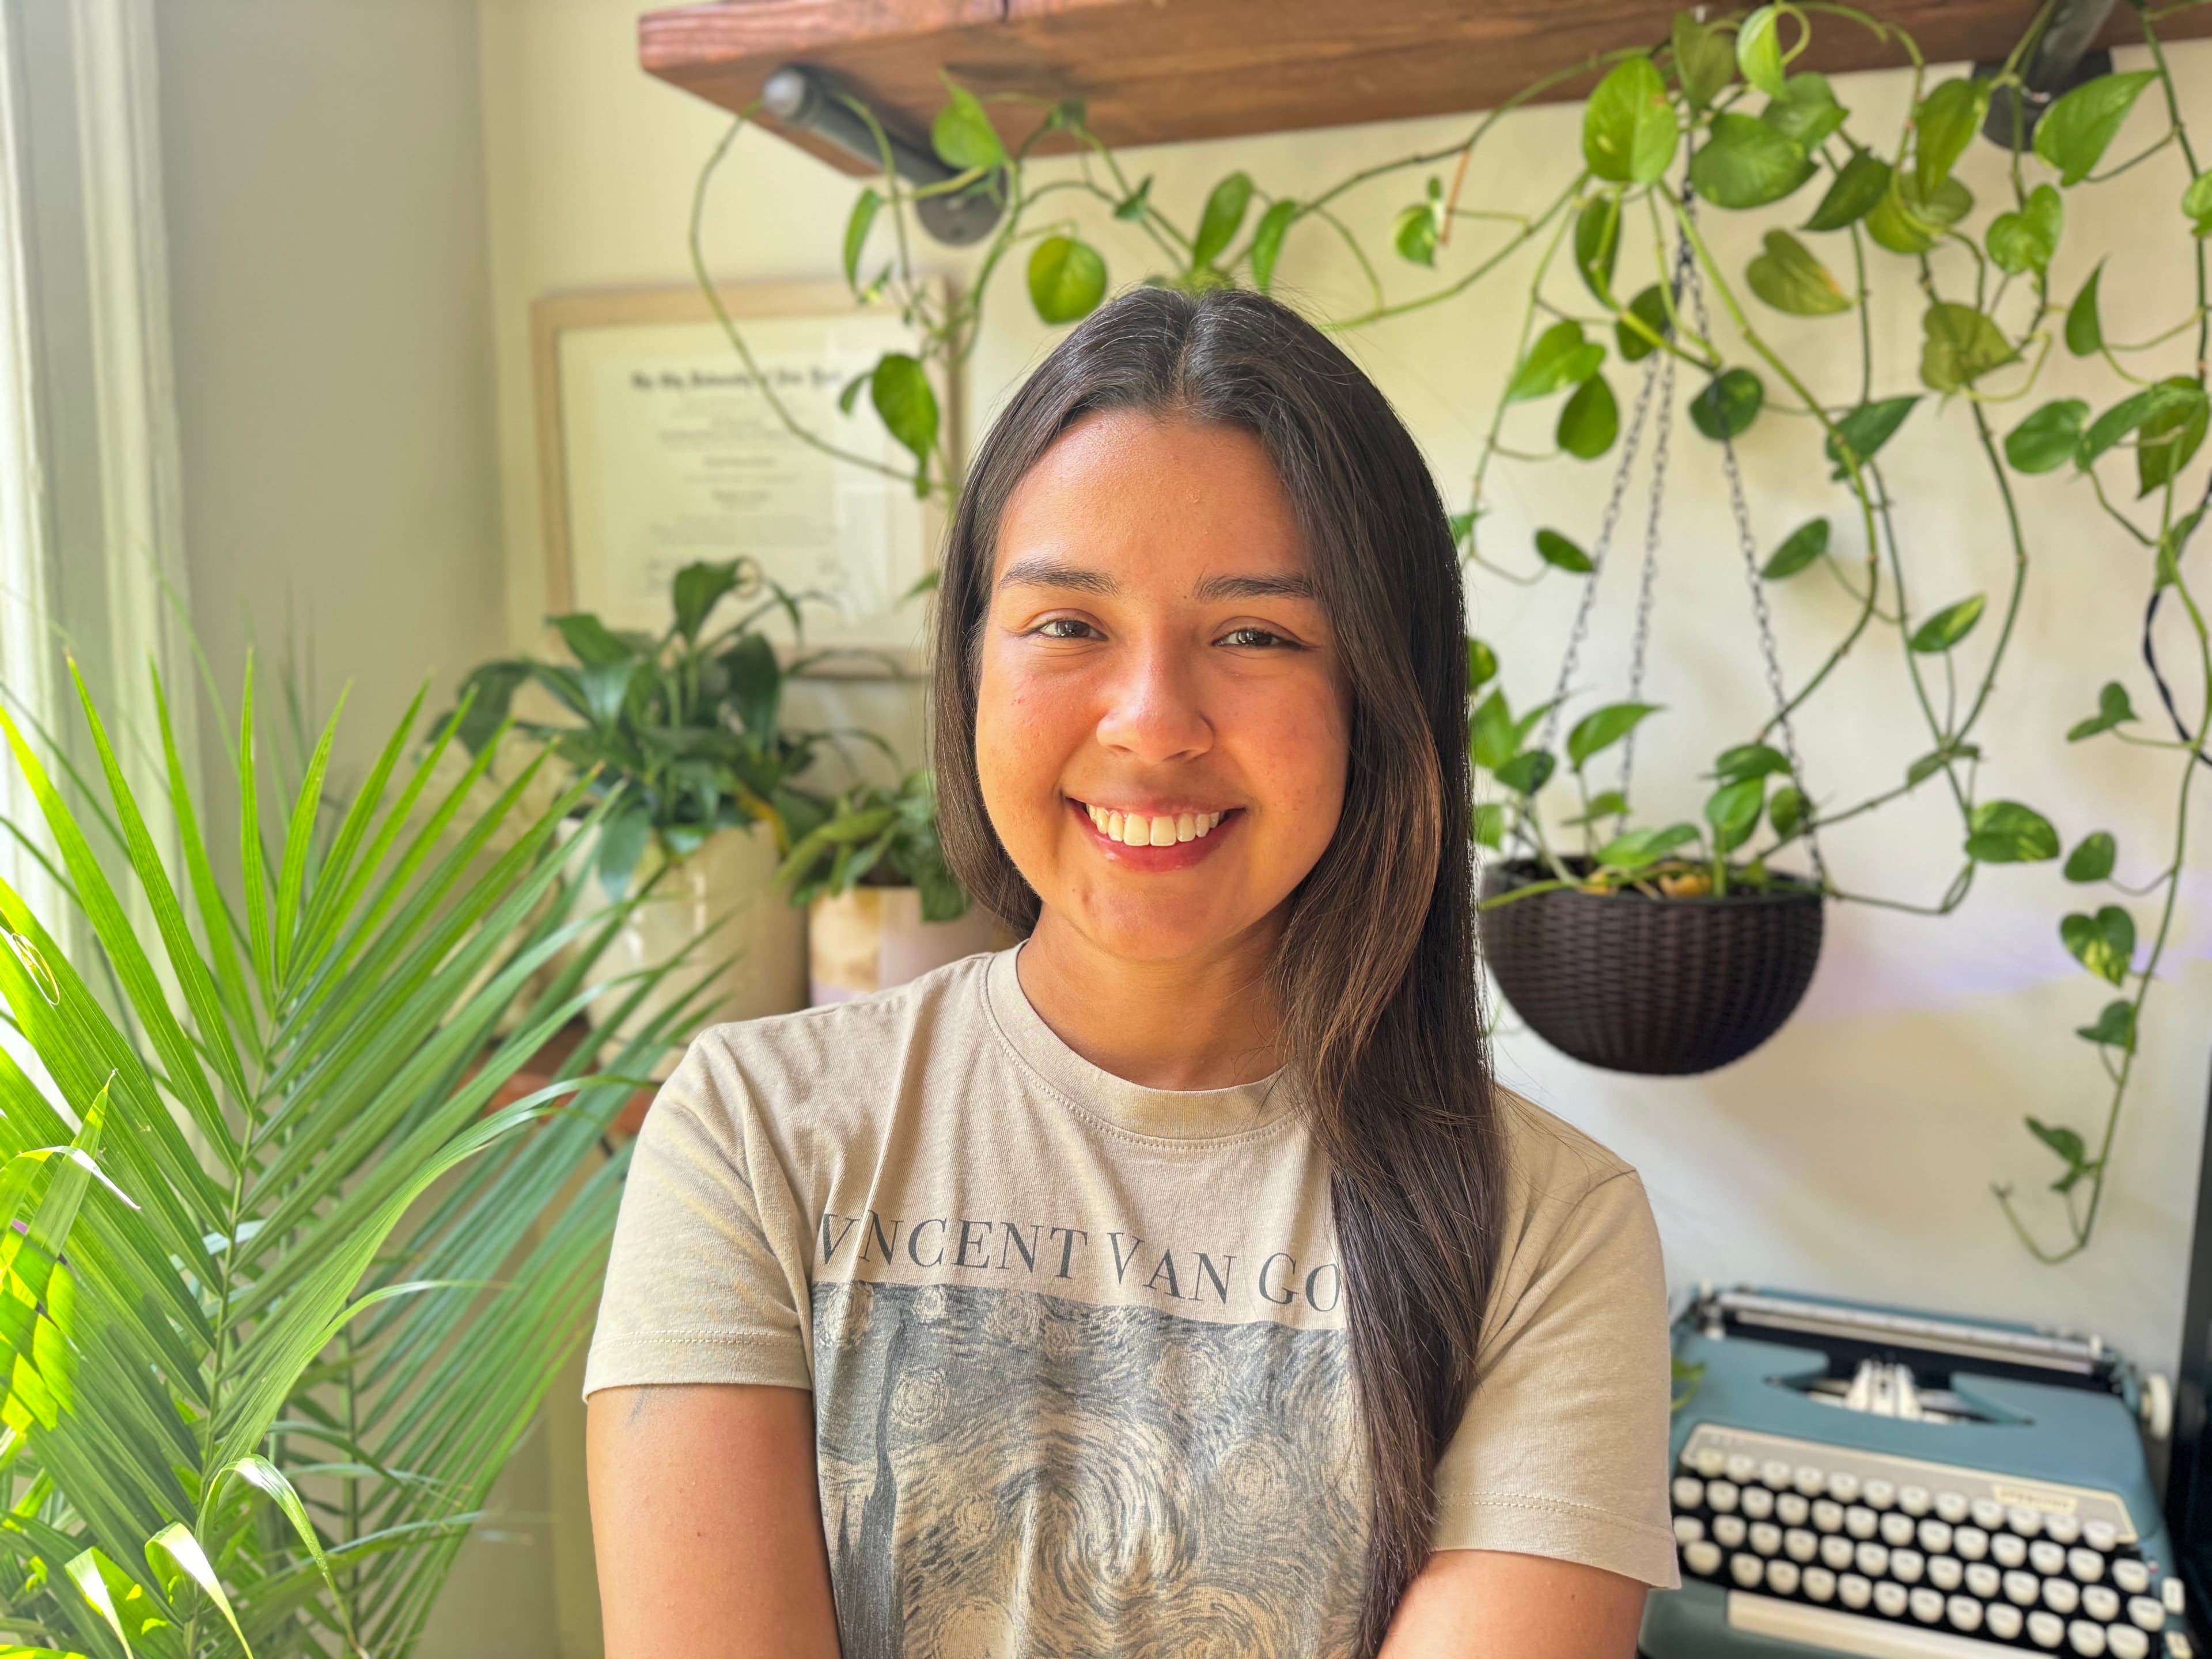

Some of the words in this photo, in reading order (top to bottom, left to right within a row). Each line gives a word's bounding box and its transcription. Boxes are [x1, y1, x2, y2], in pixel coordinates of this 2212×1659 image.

[823, 1210, 1088, 1280] VNCENT
[1107, 1232, 1237, 1305] VAN
[1259, 1252, 1342, 1312] GO
